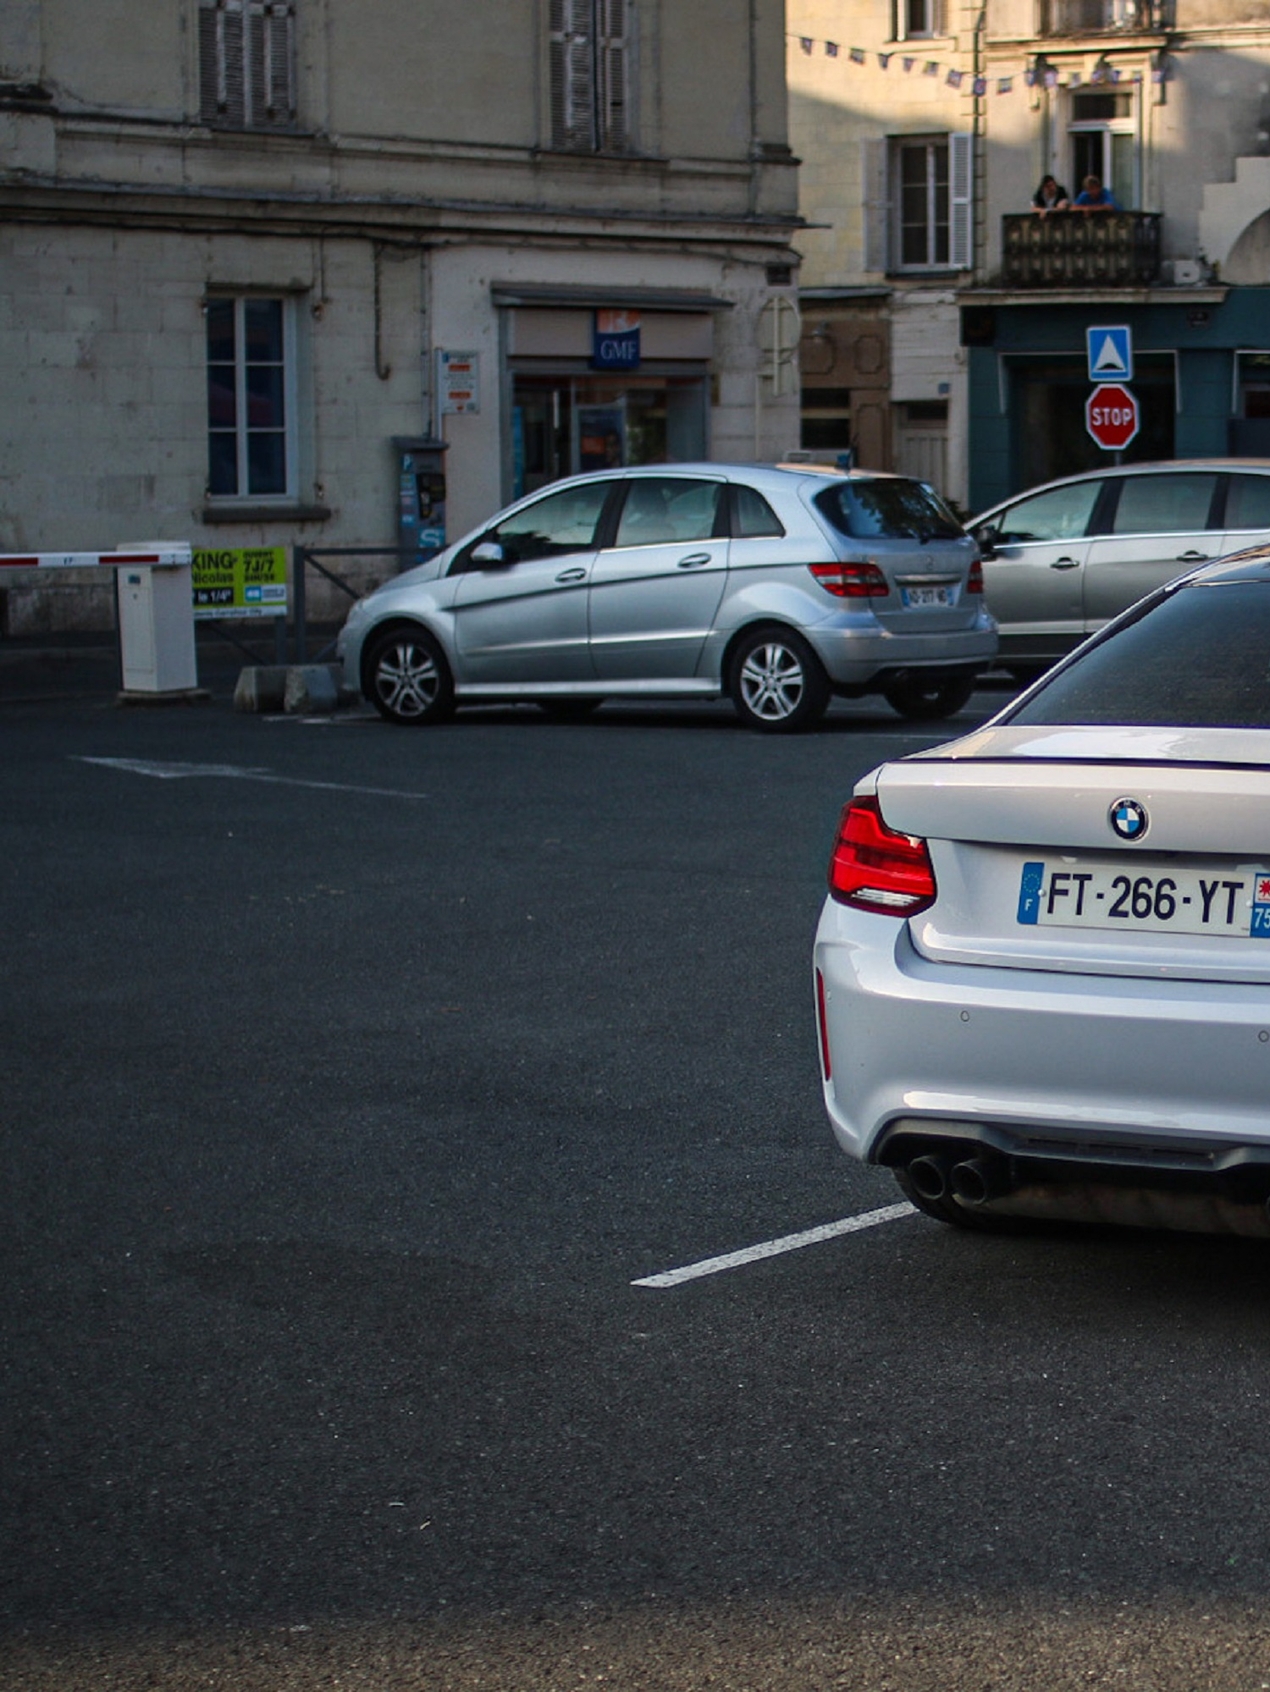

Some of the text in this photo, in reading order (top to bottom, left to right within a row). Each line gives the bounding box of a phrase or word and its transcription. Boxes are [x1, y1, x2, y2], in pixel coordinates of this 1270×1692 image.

[600, 340, 637, 360] GMF
[1092, 407, 1133, 426] STOP
[1023, 898, 1033, 912] F
[1046, 872, 1245, 924] FT-266-YT
